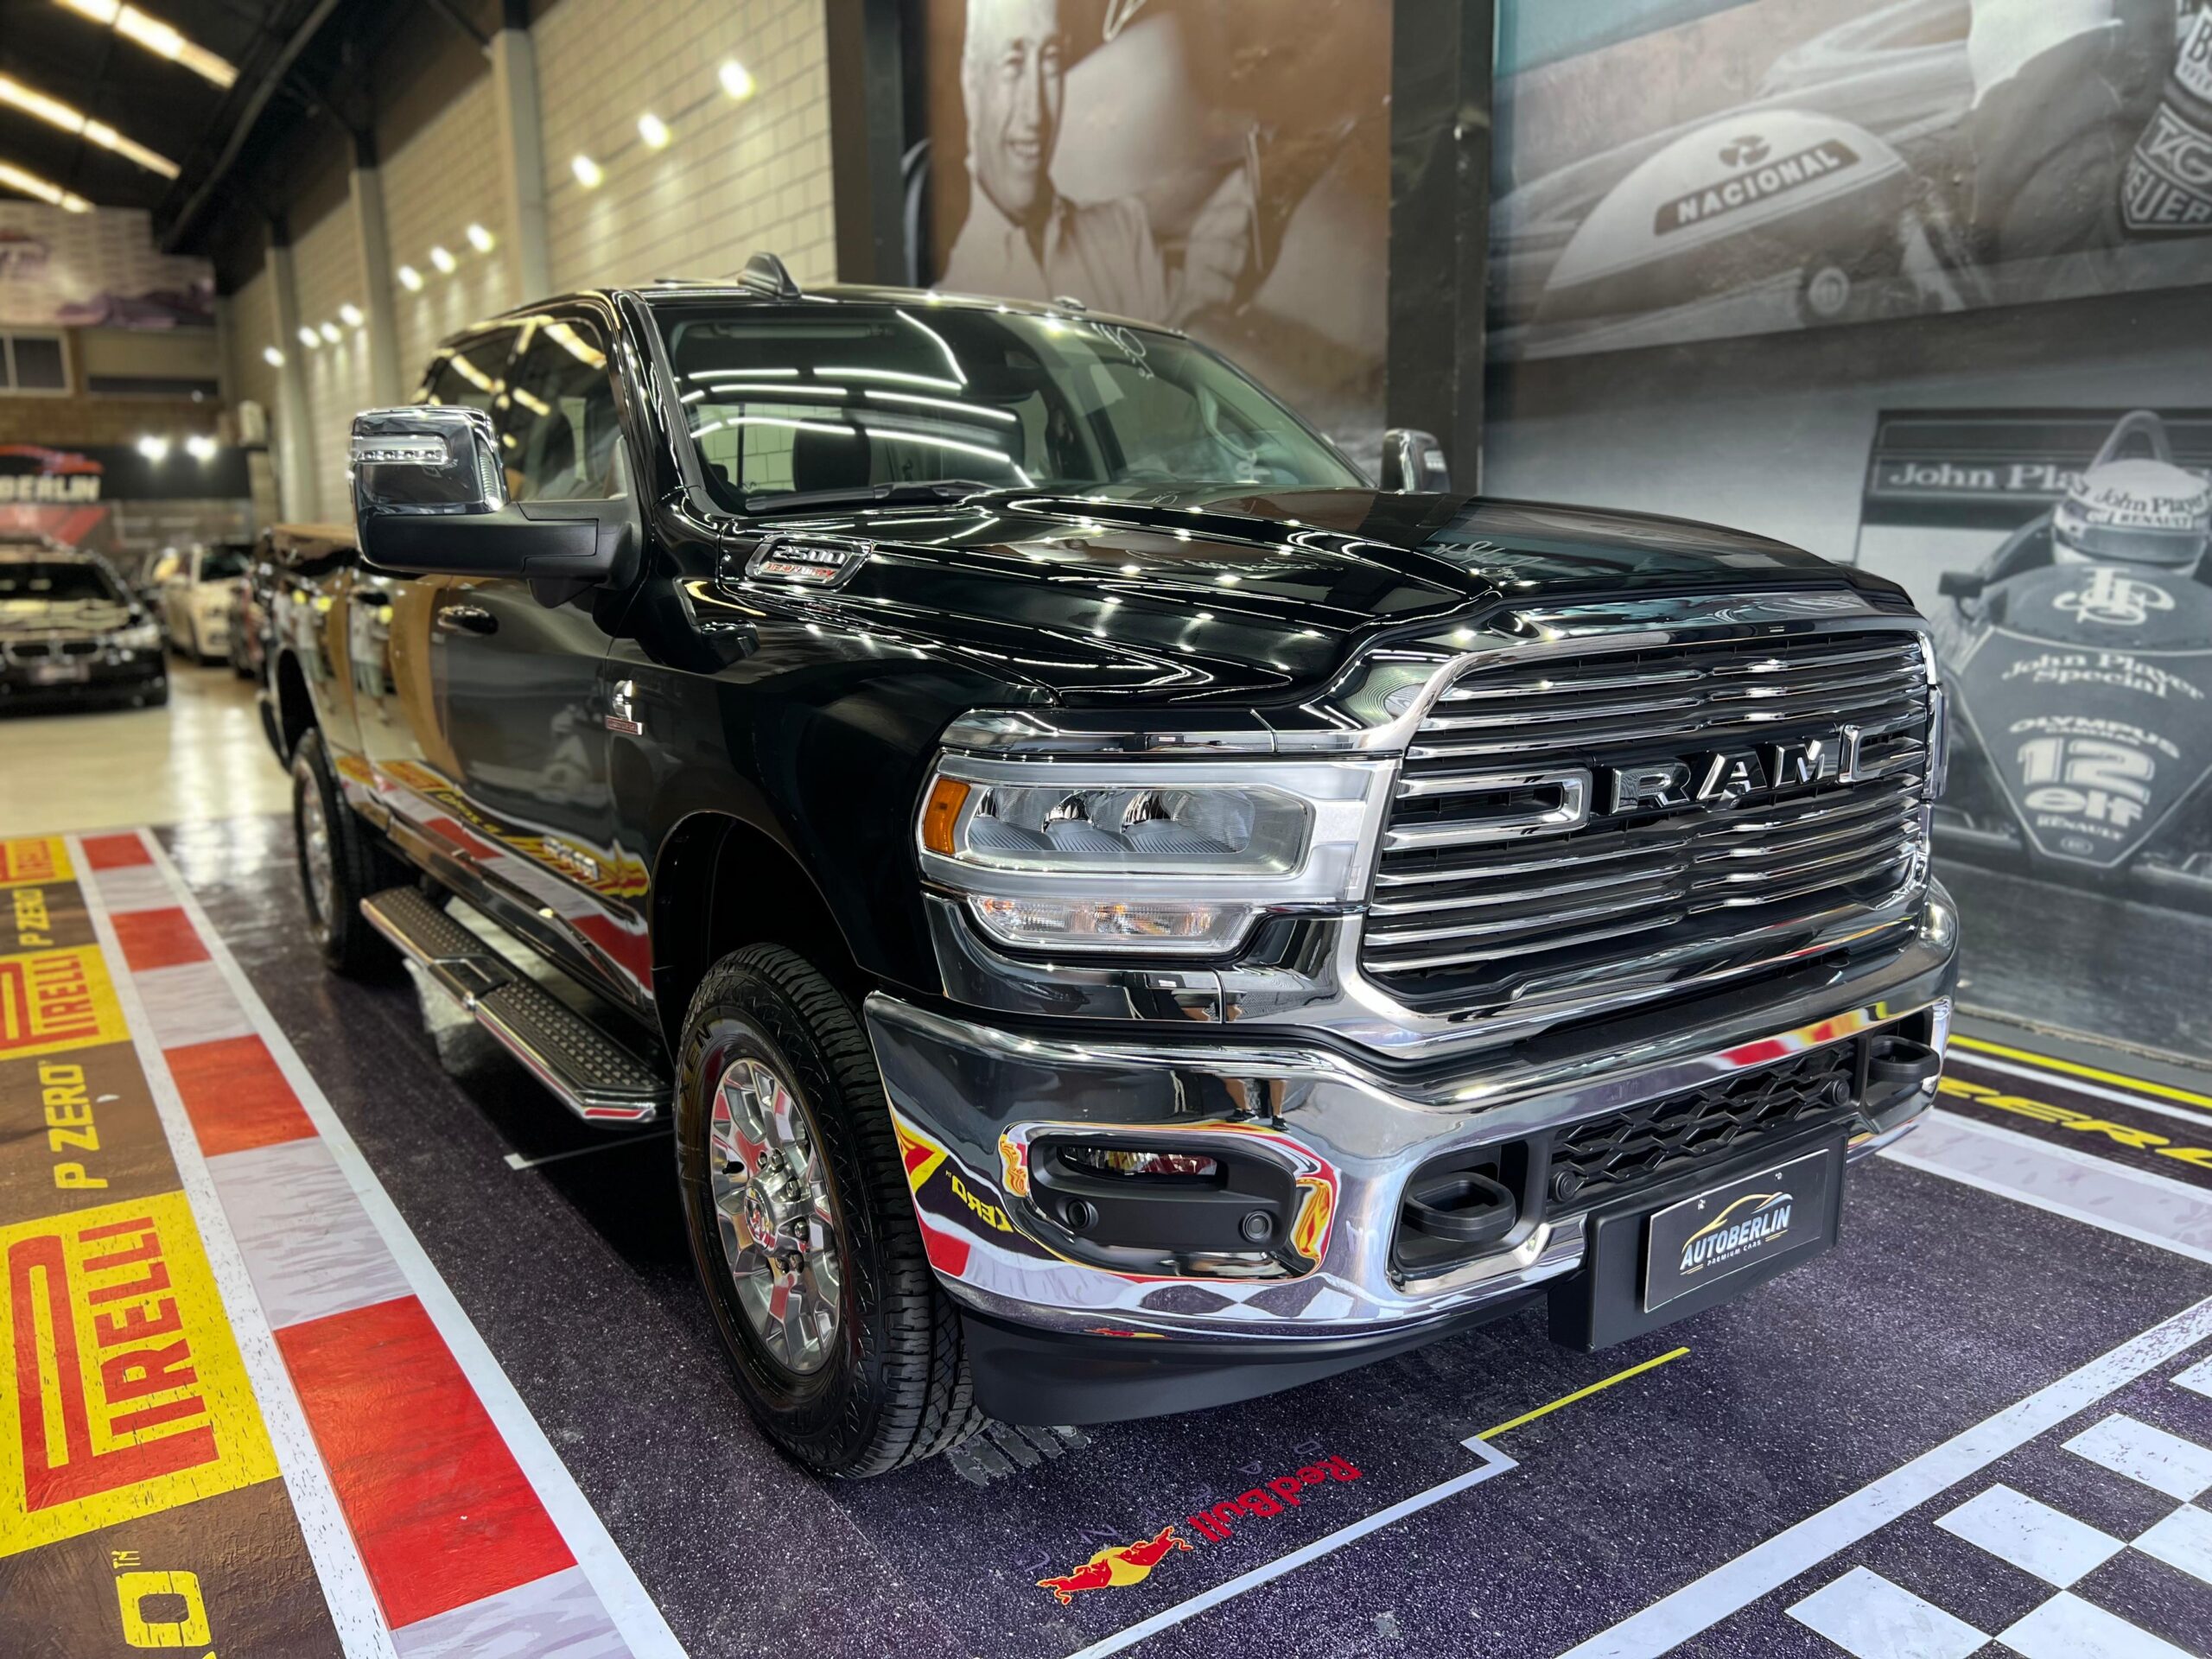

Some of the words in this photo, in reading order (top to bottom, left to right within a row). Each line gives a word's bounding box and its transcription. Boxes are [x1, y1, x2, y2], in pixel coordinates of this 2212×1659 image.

[1677, 148, 1840, 223] NACIONAL
[1889, 462, 1995, 488] John
[2094, 487, 2148, 512] John
[772, 545, 848, 565] 2500
[2001, 653, 2088, 680] John
[2098, 652, 2205, 700] Player
[2032, 668, 2166, 697] Special
[2009, 715, 2180, 760] OLYMPUS
[1607, 738, 1841, 815] RAM
[2017, 736, 2156, 805] 12
[2024, 787, 2144, 827] elf
[2036, 815, 2125, 842] RENAULT
[0, 954, 100, 1051] PIRELLI
[39, 1064, 101, 1153] ZERO
[54, 1161, 109, 1190] P
[1679, 1205, 1791, 1271] AUTOBERLIN
[1707, 1249, 1741, 1267] PREMIUM
[1743, 1239, 1762, 1252] CARS
[8, 1216, 219, 1513] PIRELLI
